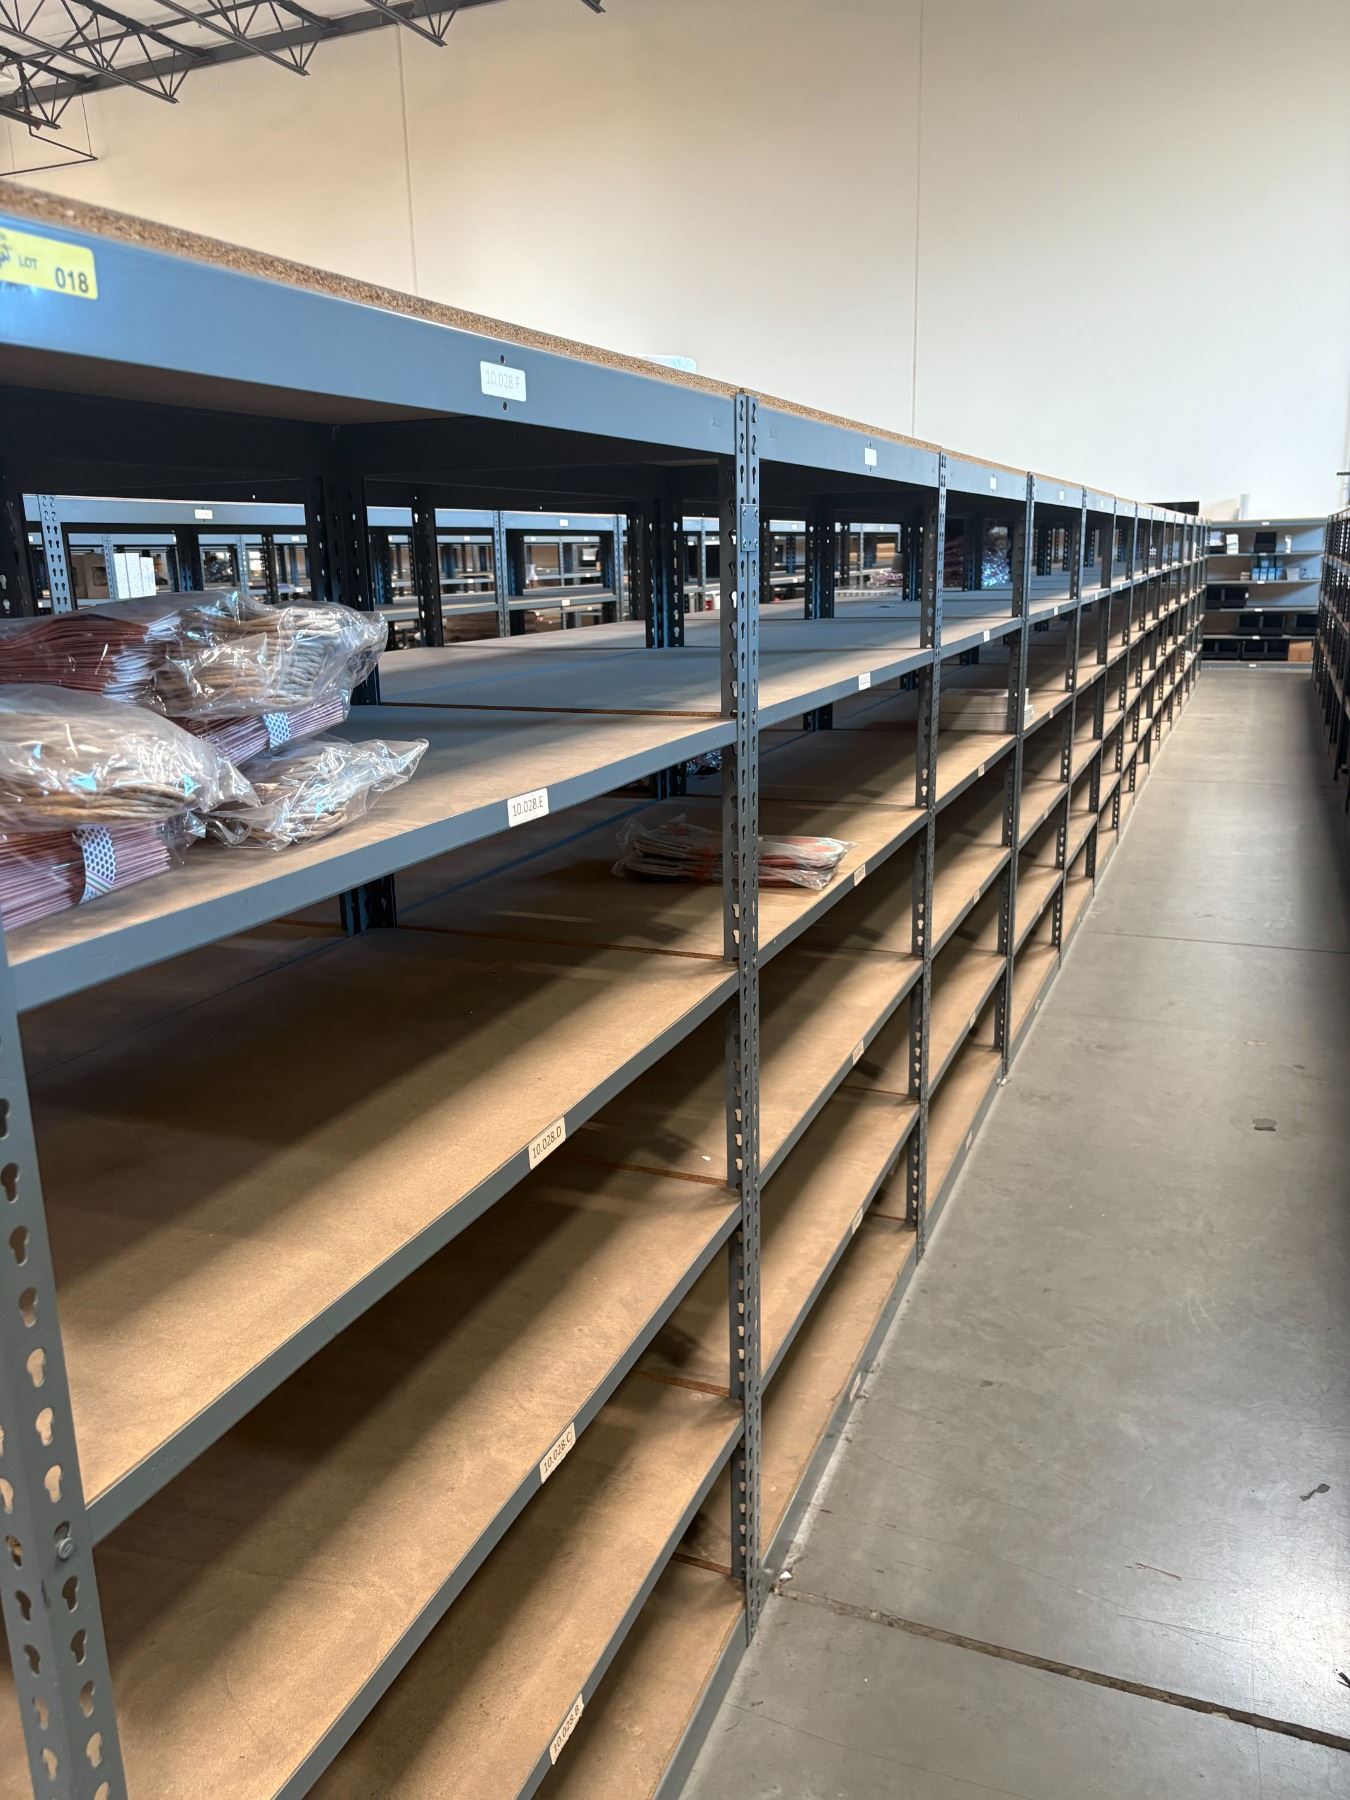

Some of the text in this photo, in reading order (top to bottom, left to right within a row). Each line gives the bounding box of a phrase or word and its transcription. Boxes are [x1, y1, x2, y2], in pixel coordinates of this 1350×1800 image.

[18, 254, 89, 294] LOT 018
[486, 369, 521, 391] 10.028.F
[512, 795, 544, 817] 10.028.E
[532, 1125, 562, 1160] 10.028.D
[543, 1431, 573, 1474] 10.028.C
